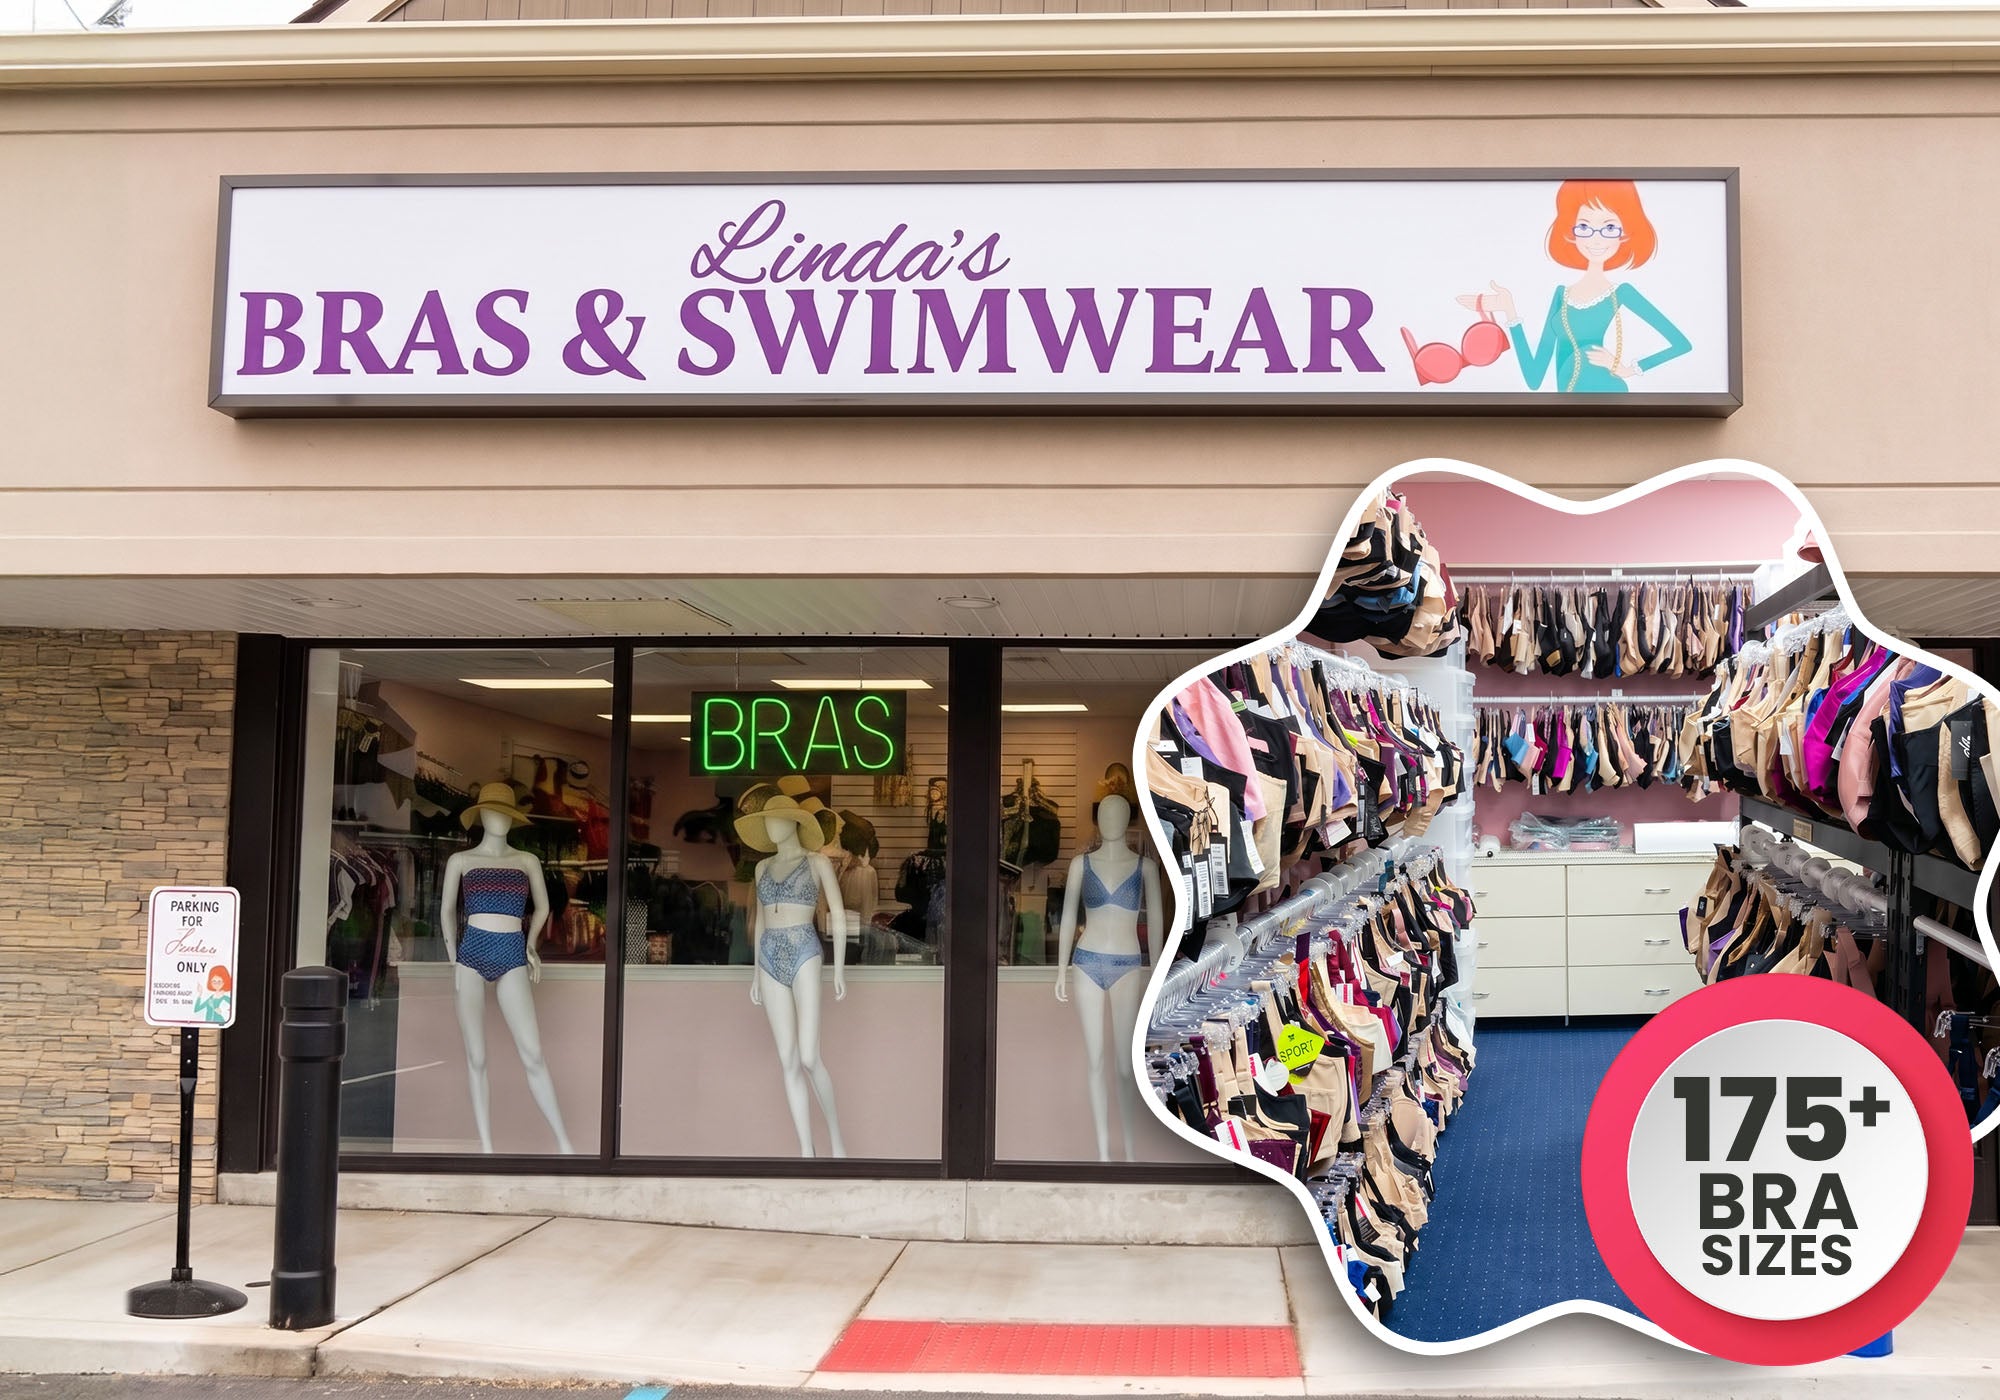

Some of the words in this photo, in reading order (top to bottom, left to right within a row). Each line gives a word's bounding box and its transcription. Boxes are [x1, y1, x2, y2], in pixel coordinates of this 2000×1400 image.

[690, 199, 1010, 284] Linda's
[237, 288, 530, 377] BRAS
[562, 288, 646, 381] &
[678, 287, 1386, 376] SWIMWEAR
[702, 695, 895, 773] BRAS
[170, 900, 219, 913] PARKING
[182, 915, 203, 927] FOR
[176, 961, 207, 973] ONLY
[1279, 1040, 1314, 1063] SPORT
